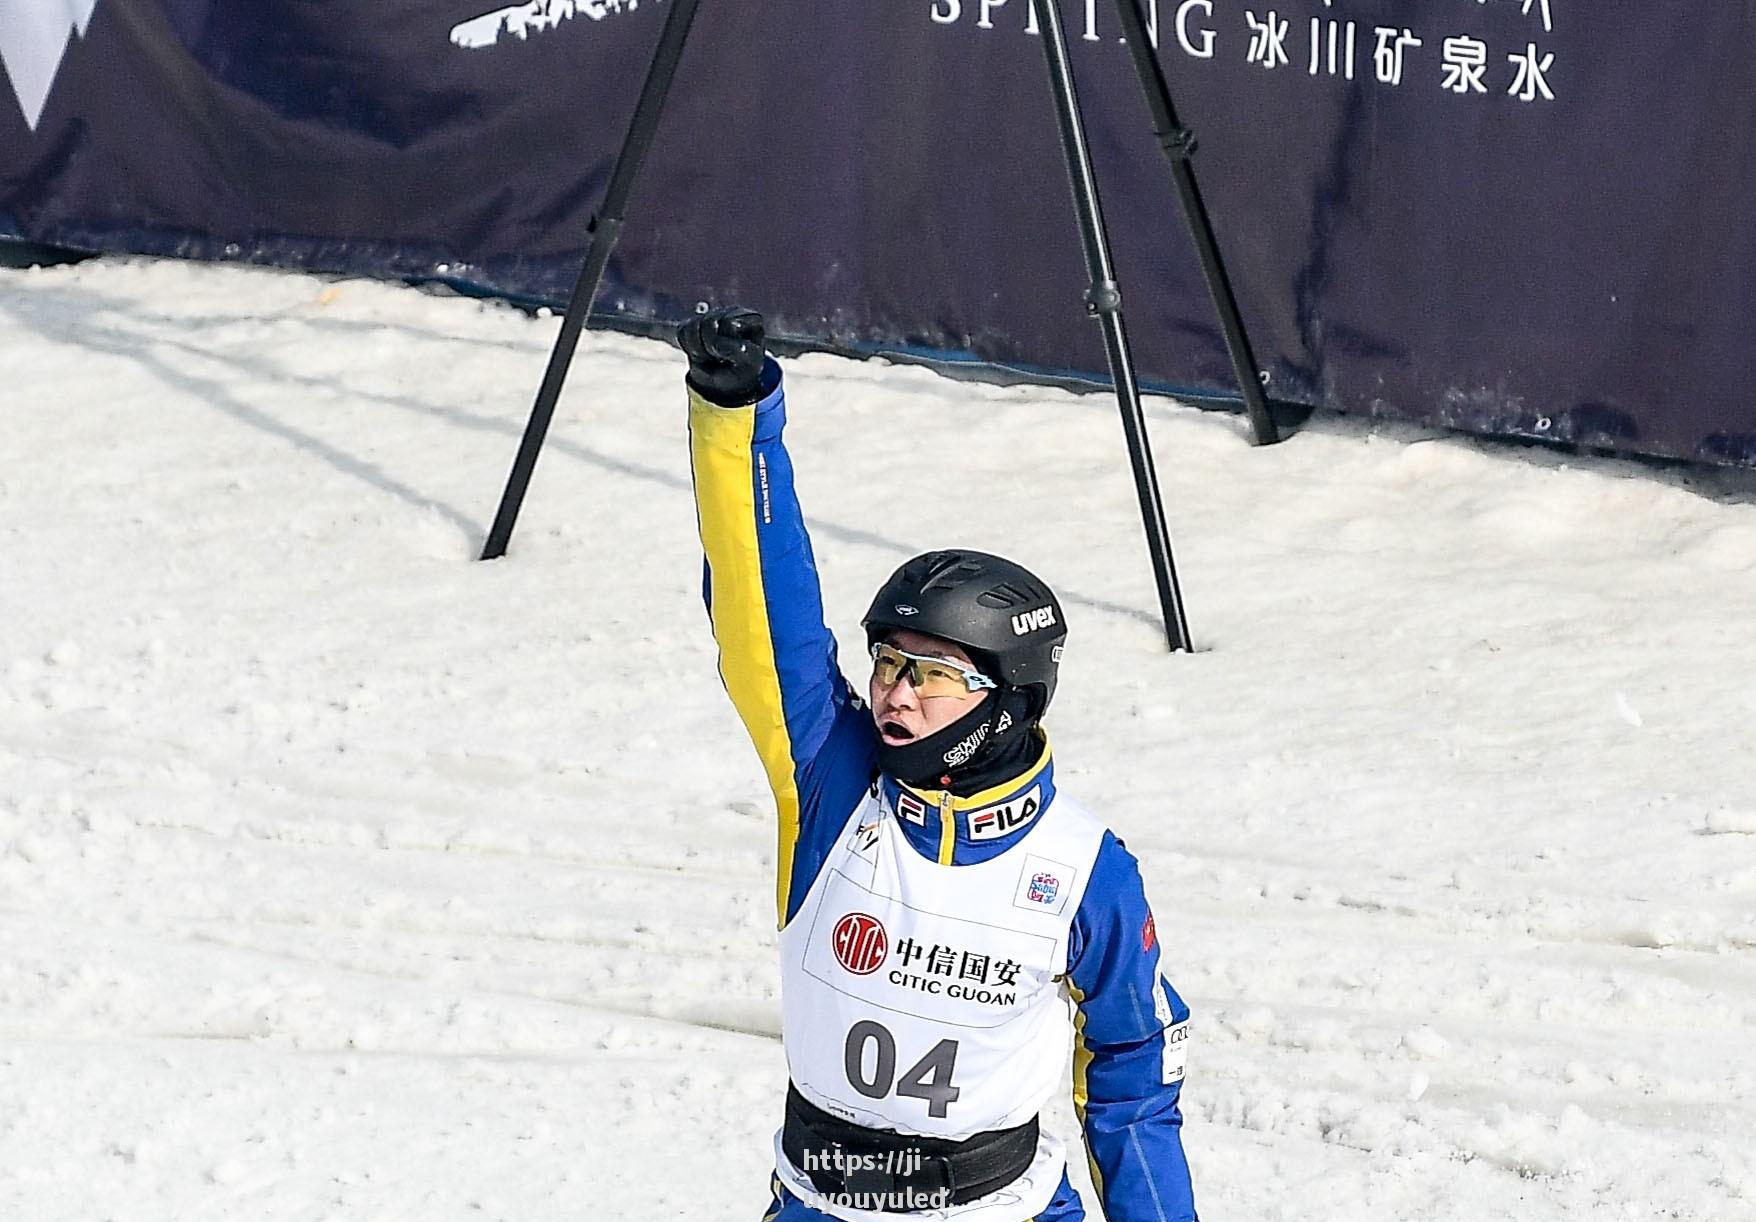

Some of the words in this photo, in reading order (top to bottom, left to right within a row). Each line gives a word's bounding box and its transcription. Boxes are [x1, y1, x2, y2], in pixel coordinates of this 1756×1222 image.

[1245, 10, 1555, 101] 冰川矿泉水
[1011, 605, 1056, 635] uvex
[973, 800, 1037, 833] FILA
[896, 937, 1022, 987] 中信国安
[888, 970, 942, 995] CITIC
[946, 982, 1017, 1006] GUOAN
[844, 1019, 961, 1119] 04
